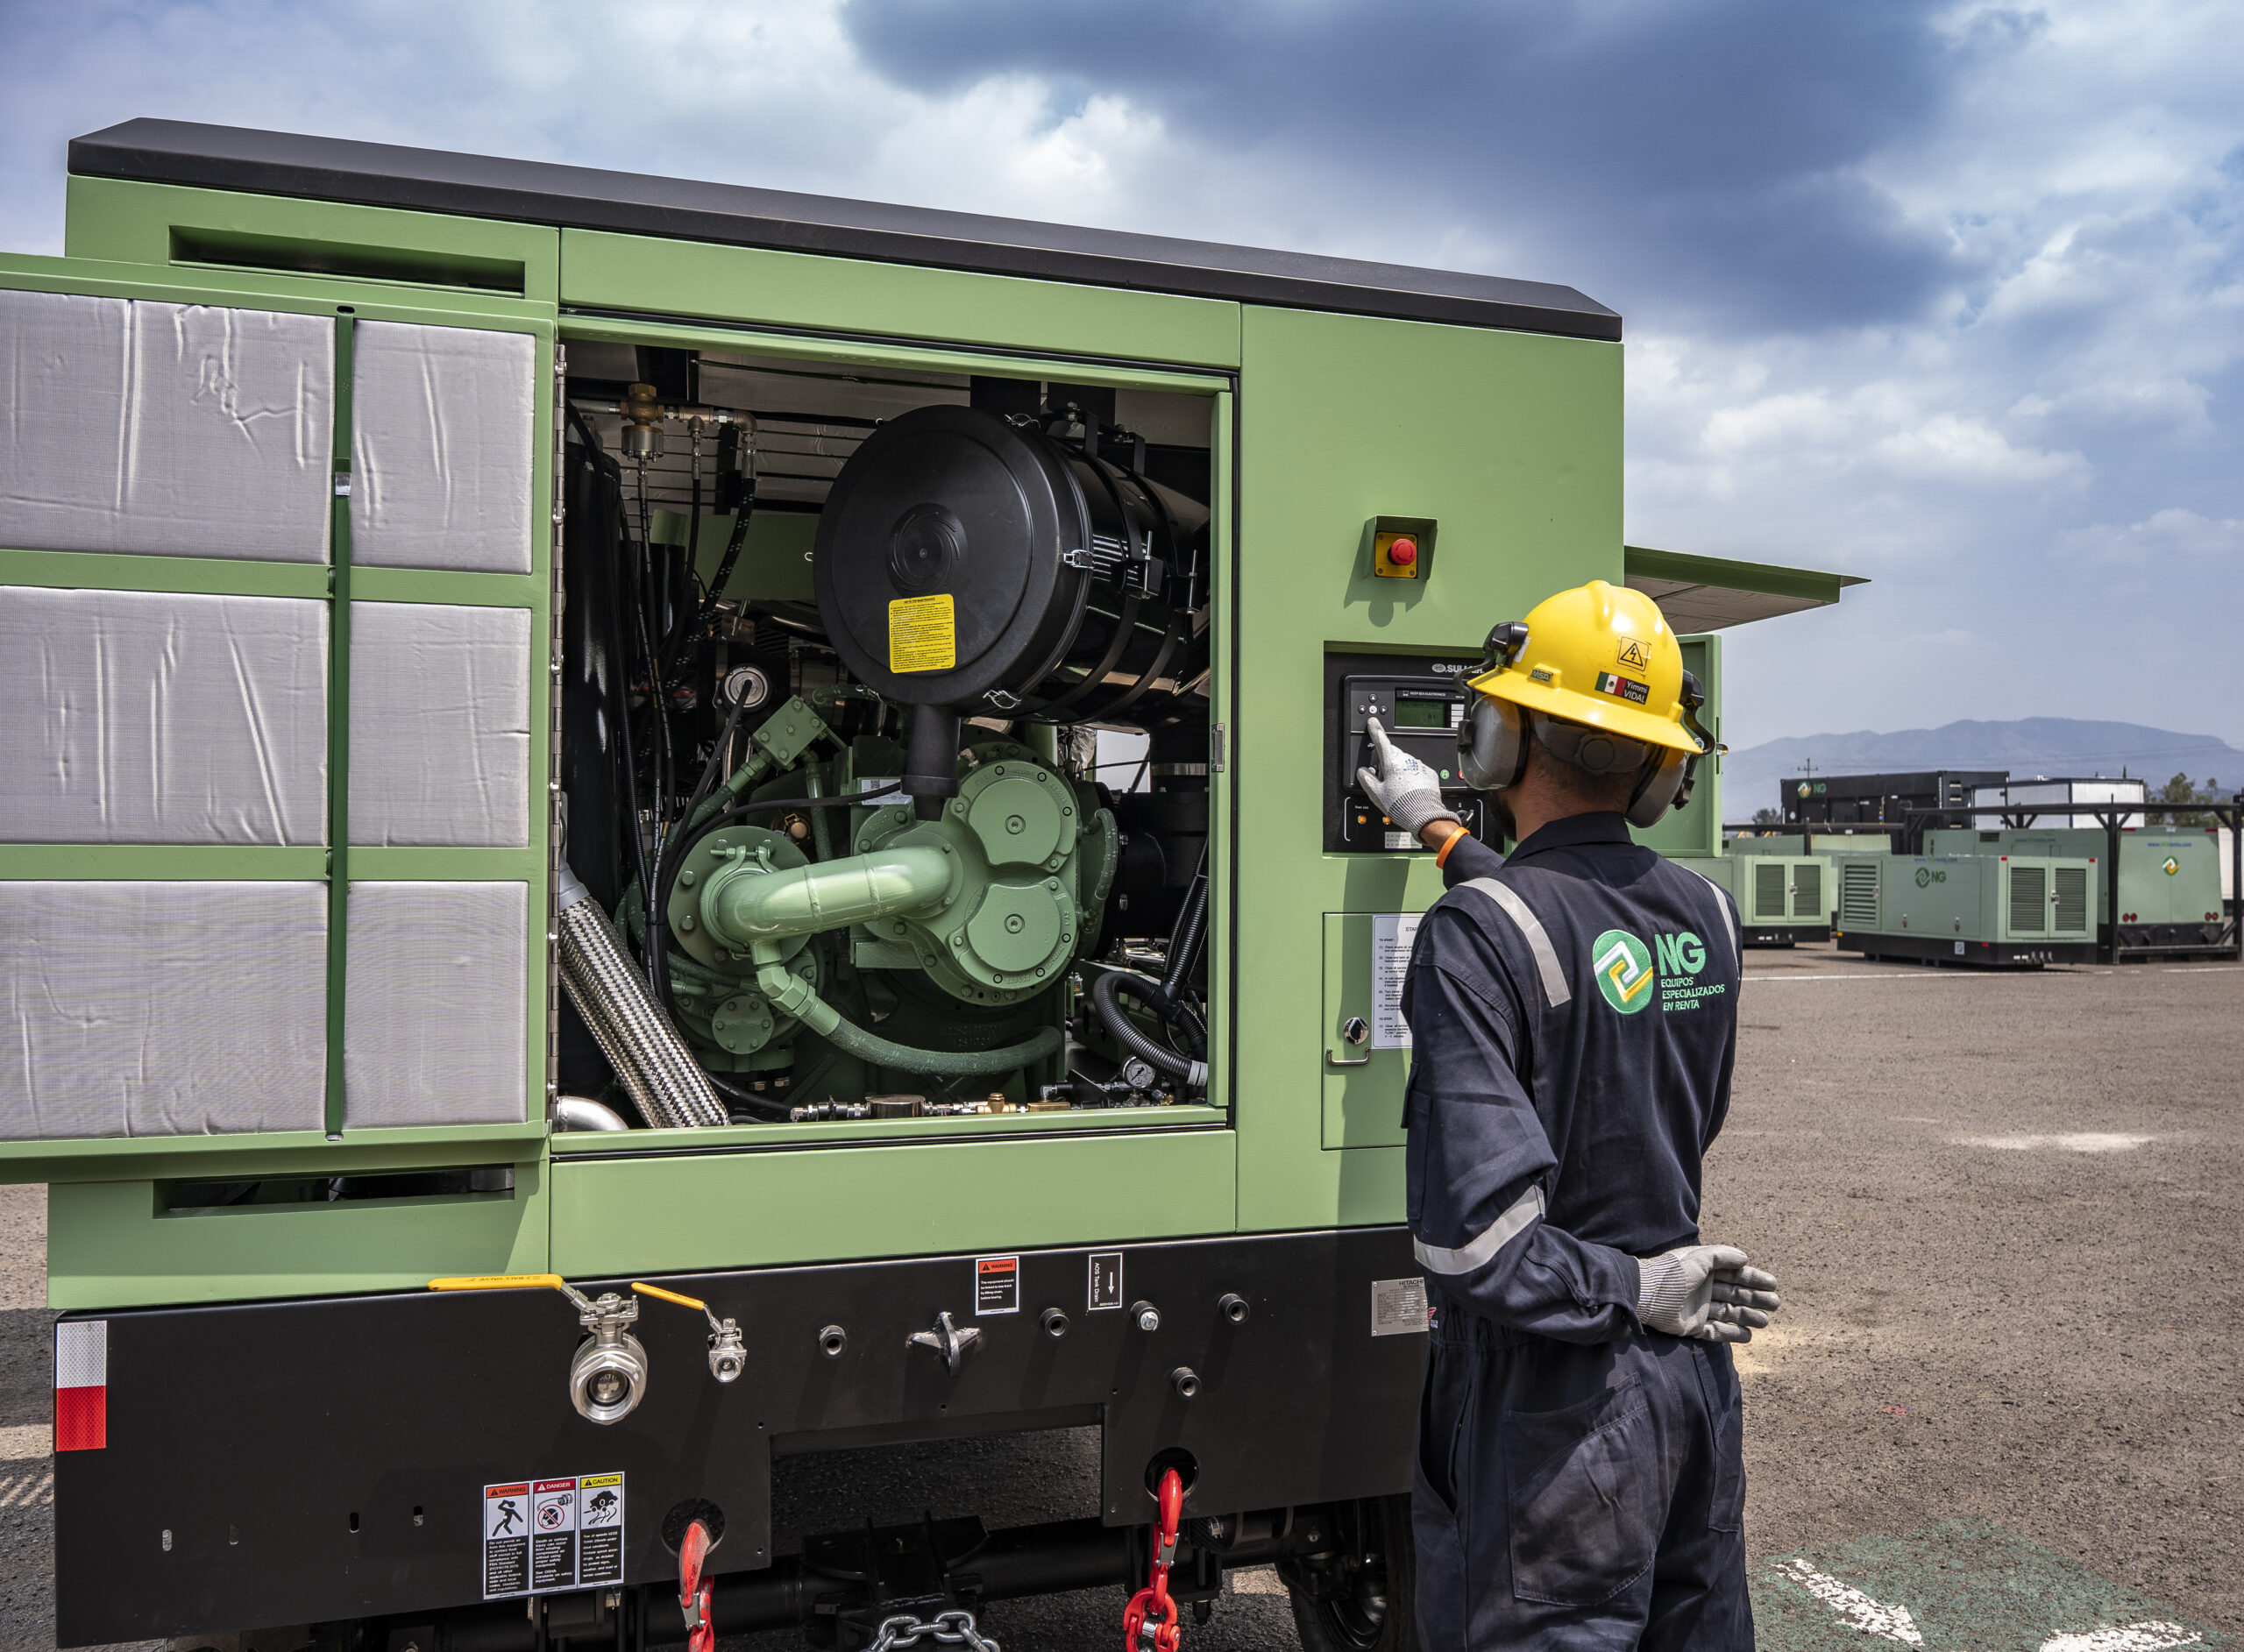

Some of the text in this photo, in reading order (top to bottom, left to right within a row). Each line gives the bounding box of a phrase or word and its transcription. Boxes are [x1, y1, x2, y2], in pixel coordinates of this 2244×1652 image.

[1533, 670, 1550, 681] MSA
[1627, 681, 1649, 694] Yimmi
[1624, 690, 1646, 704] VIDAL
[1814, 783, 1826, 794] NG
[1931, 871, 1946, 883] NG
[1655, 932, 1706, 976] NG
[1661, 977, 1694, 988] EQUIPOS
[1662, 984, 1725, 1000] ESPECIALIZADOS
[1663, 1000, 1700, 1011] EN RENTA
